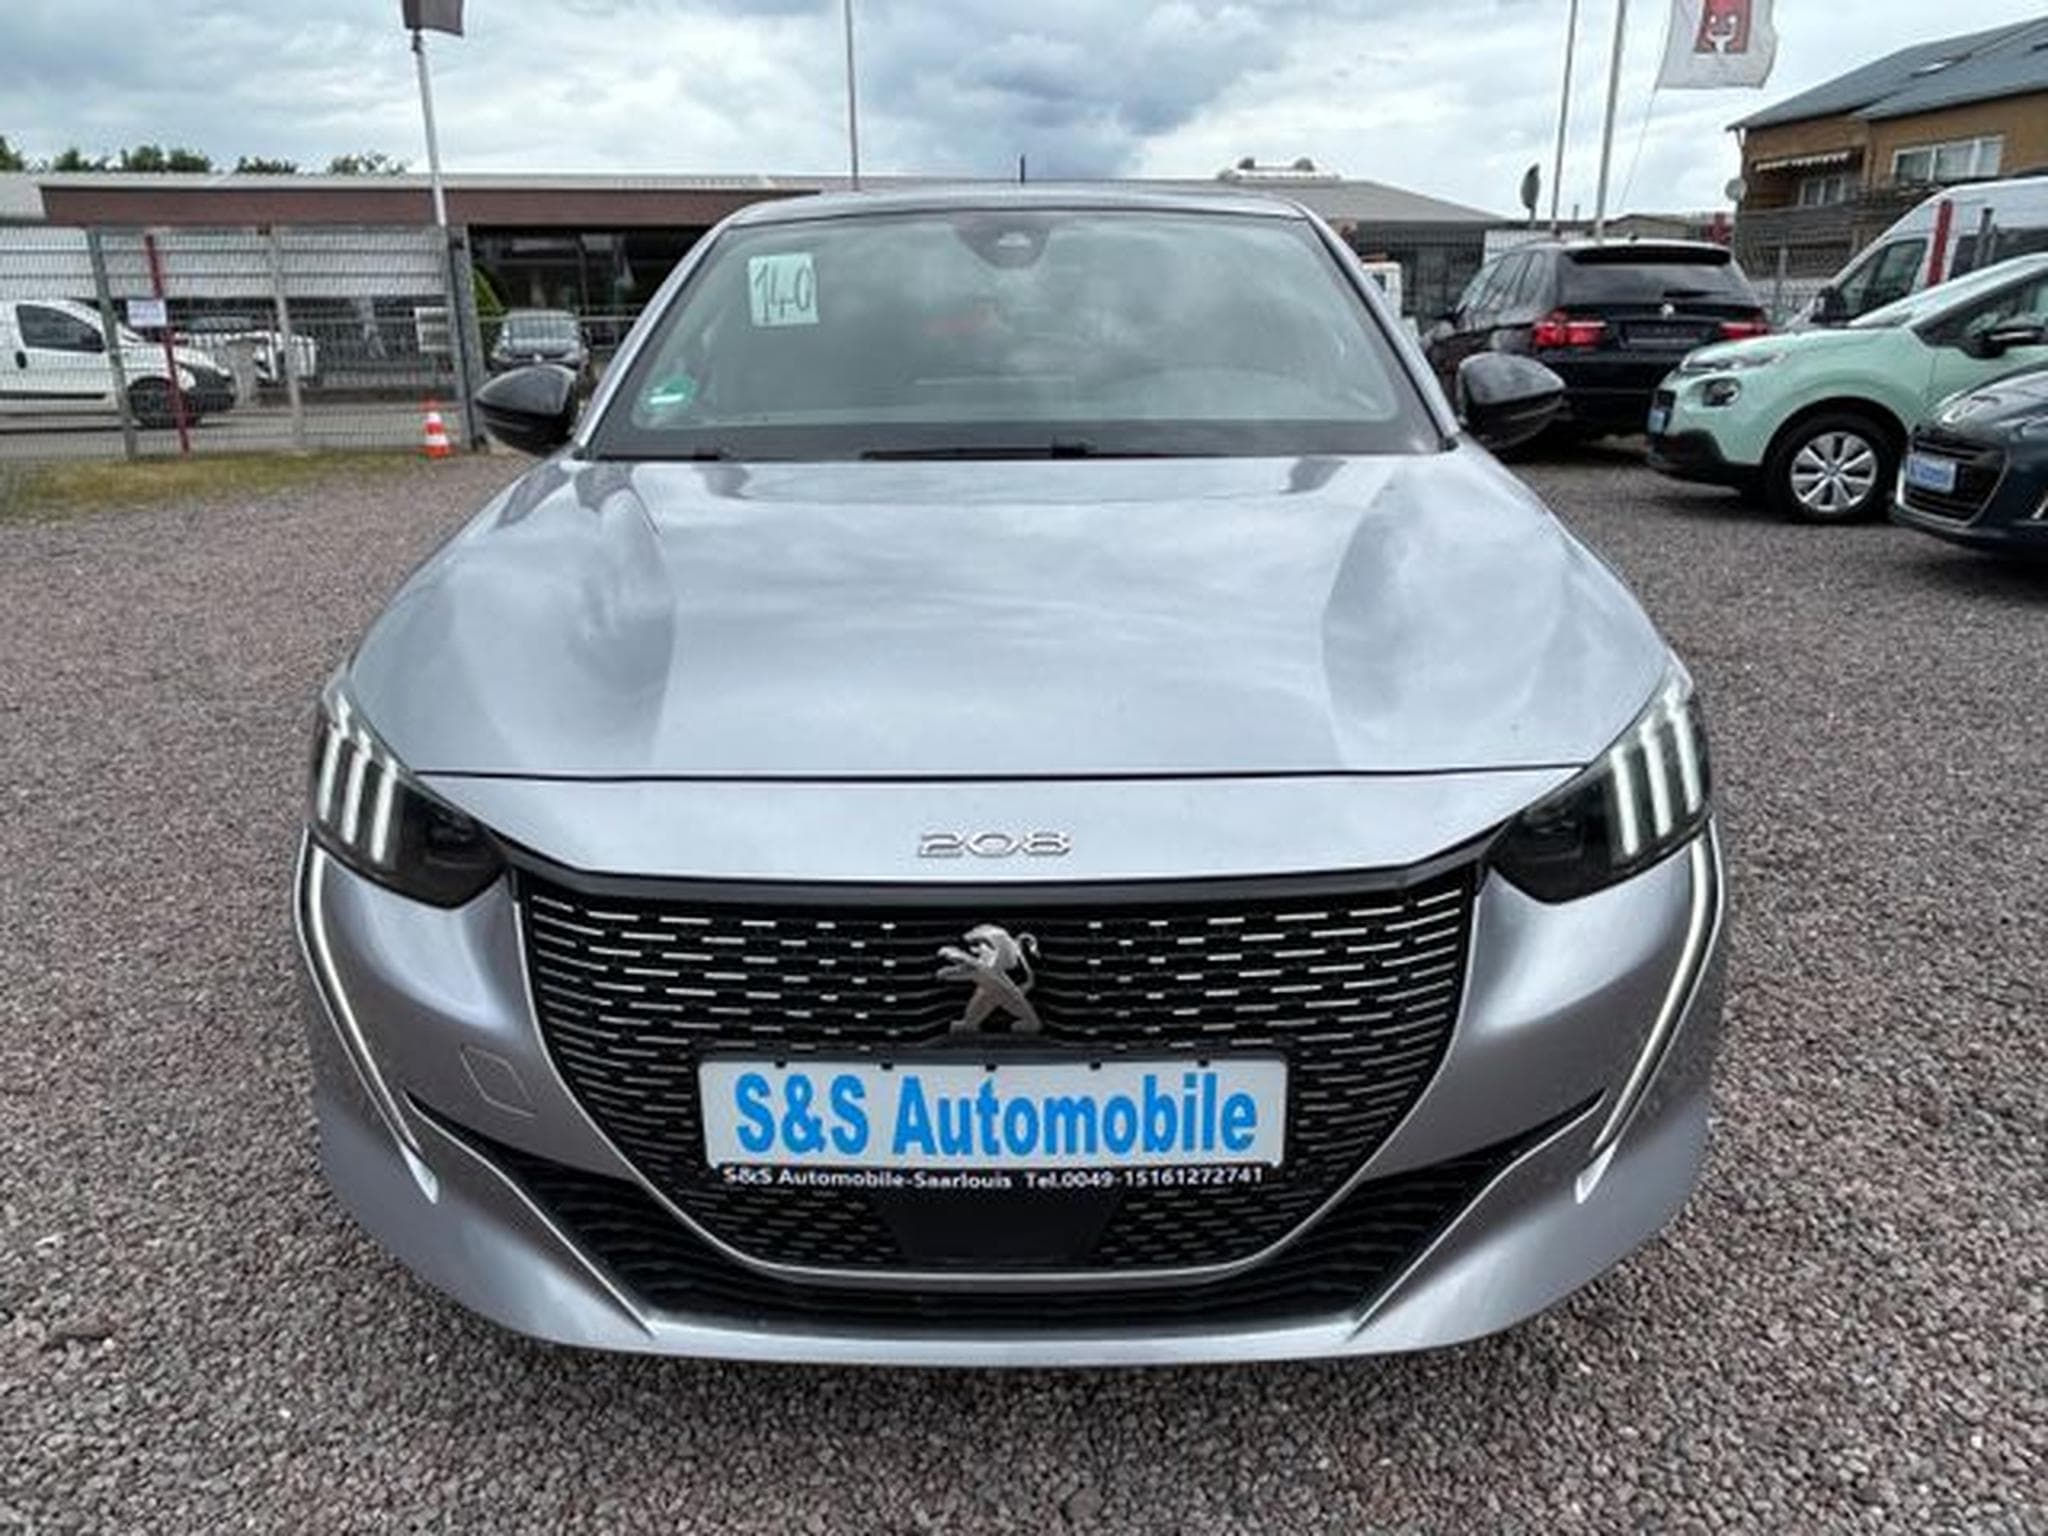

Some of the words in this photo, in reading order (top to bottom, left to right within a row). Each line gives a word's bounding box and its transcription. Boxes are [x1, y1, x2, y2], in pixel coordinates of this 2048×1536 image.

[917, 832, 1071, 858] 208
[734, 1073, 870, 1154] S&S
[892, 1072, 1259, 1156] Automobile
[722, 1167, 772, 1185] S&S
[776, 1168, 1013, 1189] Automobile-Saarlouis
